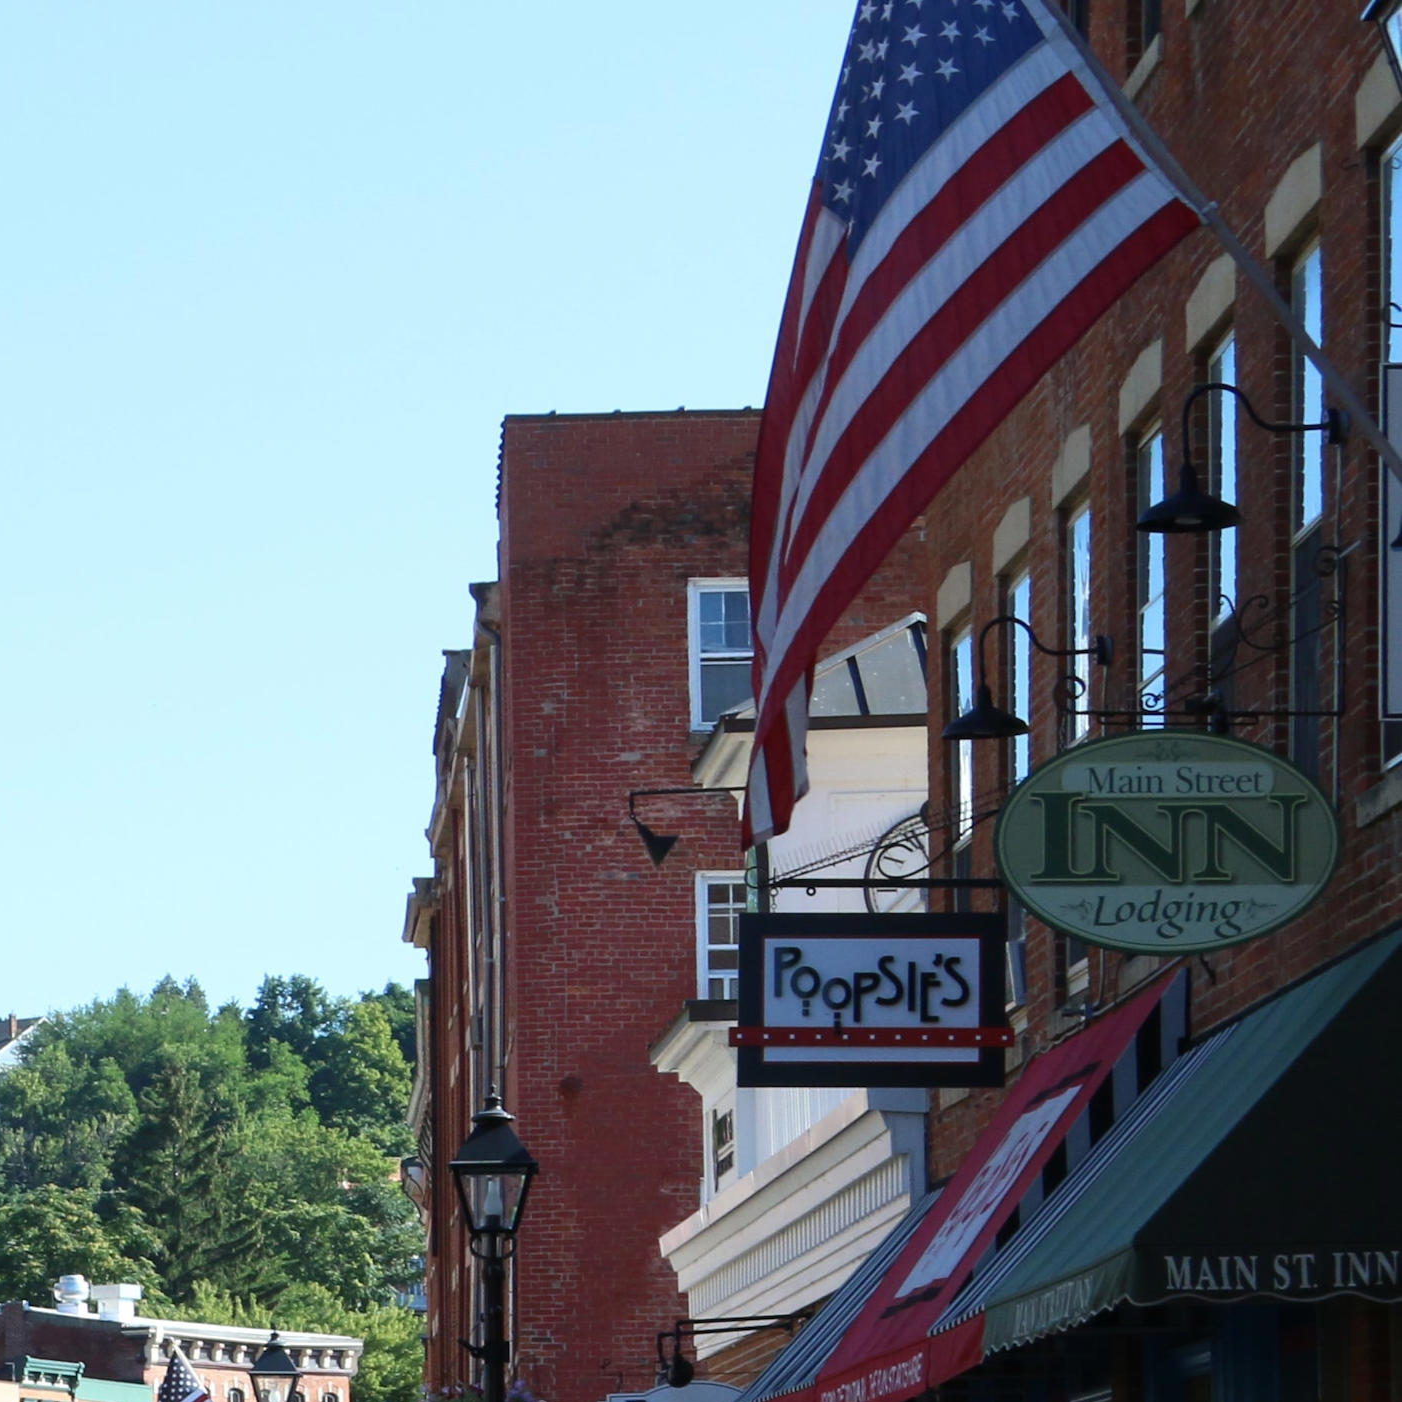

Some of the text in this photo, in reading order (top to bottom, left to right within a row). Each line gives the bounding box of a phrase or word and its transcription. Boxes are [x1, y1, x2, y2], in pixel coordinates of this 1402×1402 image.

[1086, 766, 1264, 794] Main Street
[1030, 791, 1308, 883] INN
[1093, 889, 1245, 939] Lodging
[774, 946, 970, 1028] POOPSIE'S
[1164, 1250, 1400, 1291] MAIN ST. INN
